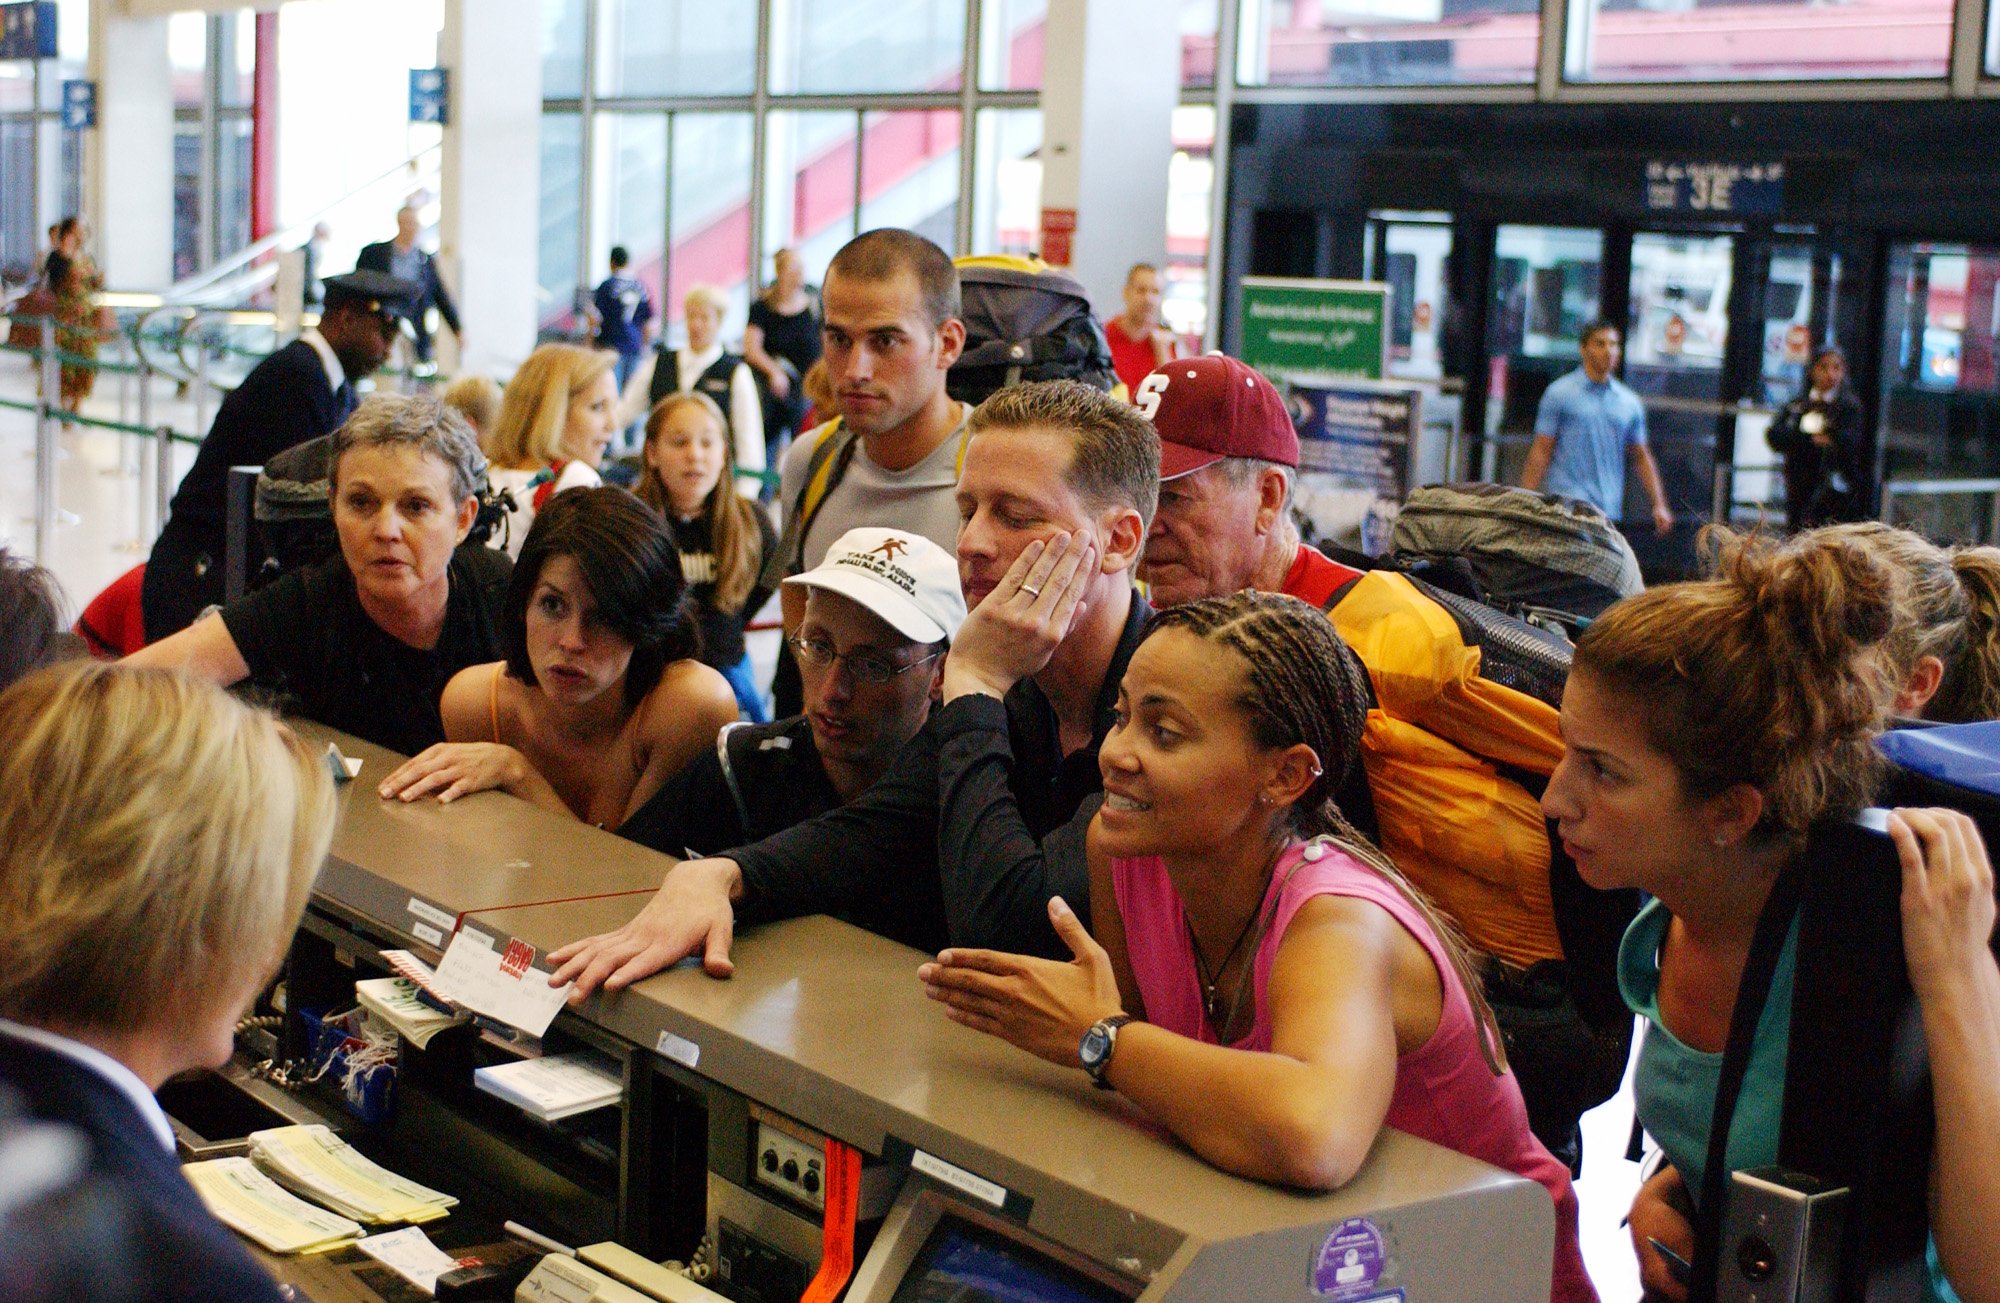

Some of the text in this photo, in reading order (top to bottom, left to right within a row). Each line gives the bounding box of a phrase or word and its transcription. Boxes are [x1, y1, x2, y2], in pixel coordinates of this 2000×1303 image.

[1135, 373, 1170, 421] S
[847, 552, 875, 562] TAKE
[887, 574, 916, 597] ALASKA
